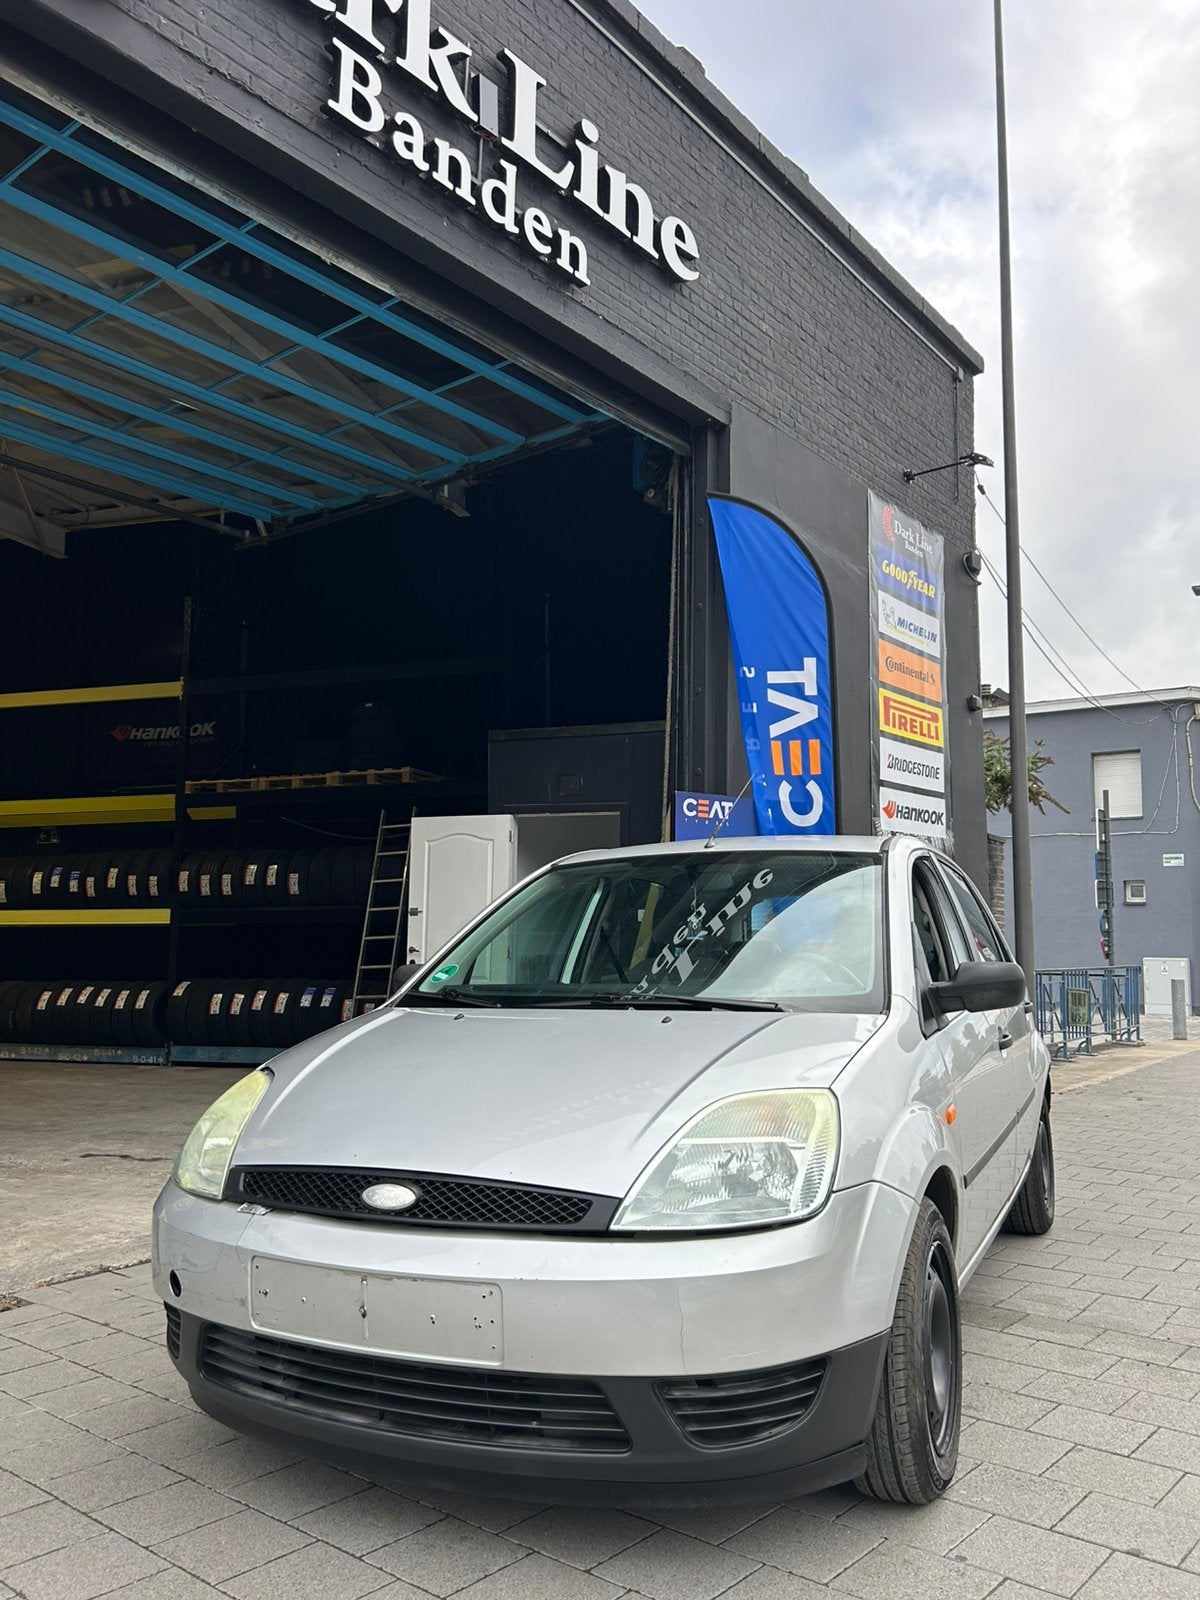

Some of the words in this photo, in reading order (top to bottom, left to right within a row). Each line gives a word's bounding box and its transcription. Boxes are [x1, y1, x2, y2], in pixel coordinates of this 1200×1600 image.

[309, 0, 478, 121] rk
[500, 47, 700, 281] Line
[327, 37, 591, 287] Banden
[894, 519, 915, 544] Dark
[915, 533, 934, 554] Line
[896, 617, 938, 643] MICHELIN
[885, 656, 929, 684] Continental
[129, 721, 216, 740] HANKOK
[883, 695, 939, 741] PIRELLI
[887, 754, 941, 780] BRIDGESTONE
[682, 797, 733, 819] CEAT
